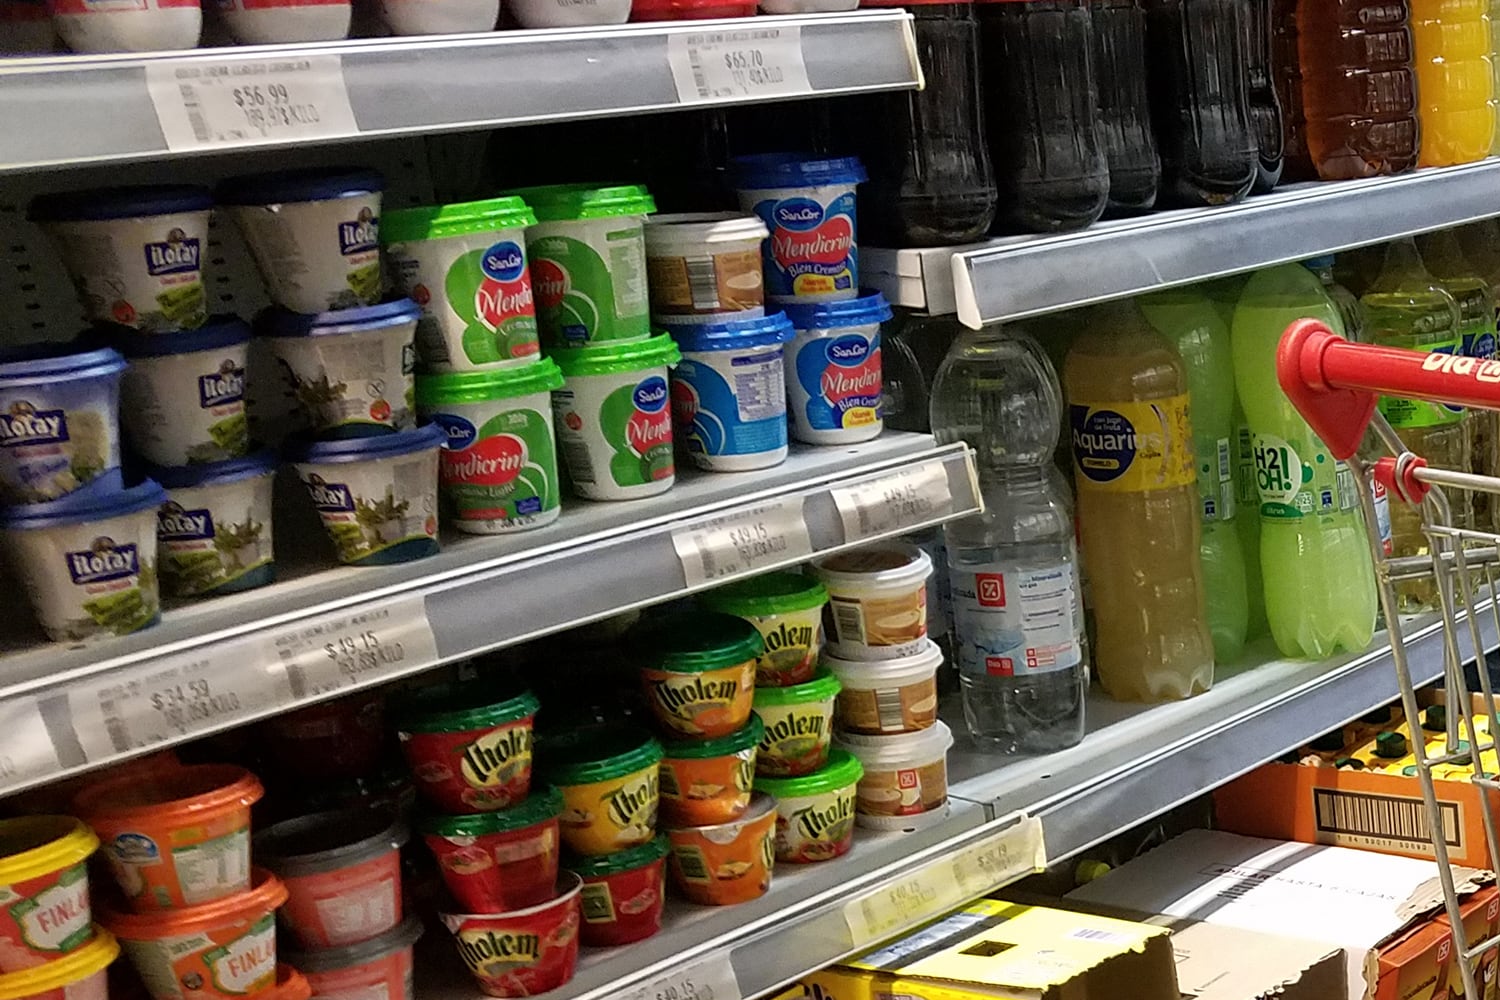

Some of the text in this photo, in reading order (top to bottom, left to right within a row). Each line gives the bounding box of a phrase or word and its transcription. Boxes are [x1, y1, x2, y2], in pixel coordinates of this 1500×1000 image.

[780, 208, 820, 221] SanCor
[773, 232, 852, 259] Mendicrim
[487, 255, 522, 271] SanCor
[832, 344, 868, 358] SanCor
[1421, 351, 1475, 376] Dia
[1073, 428, 1162, 455] Aquarius
